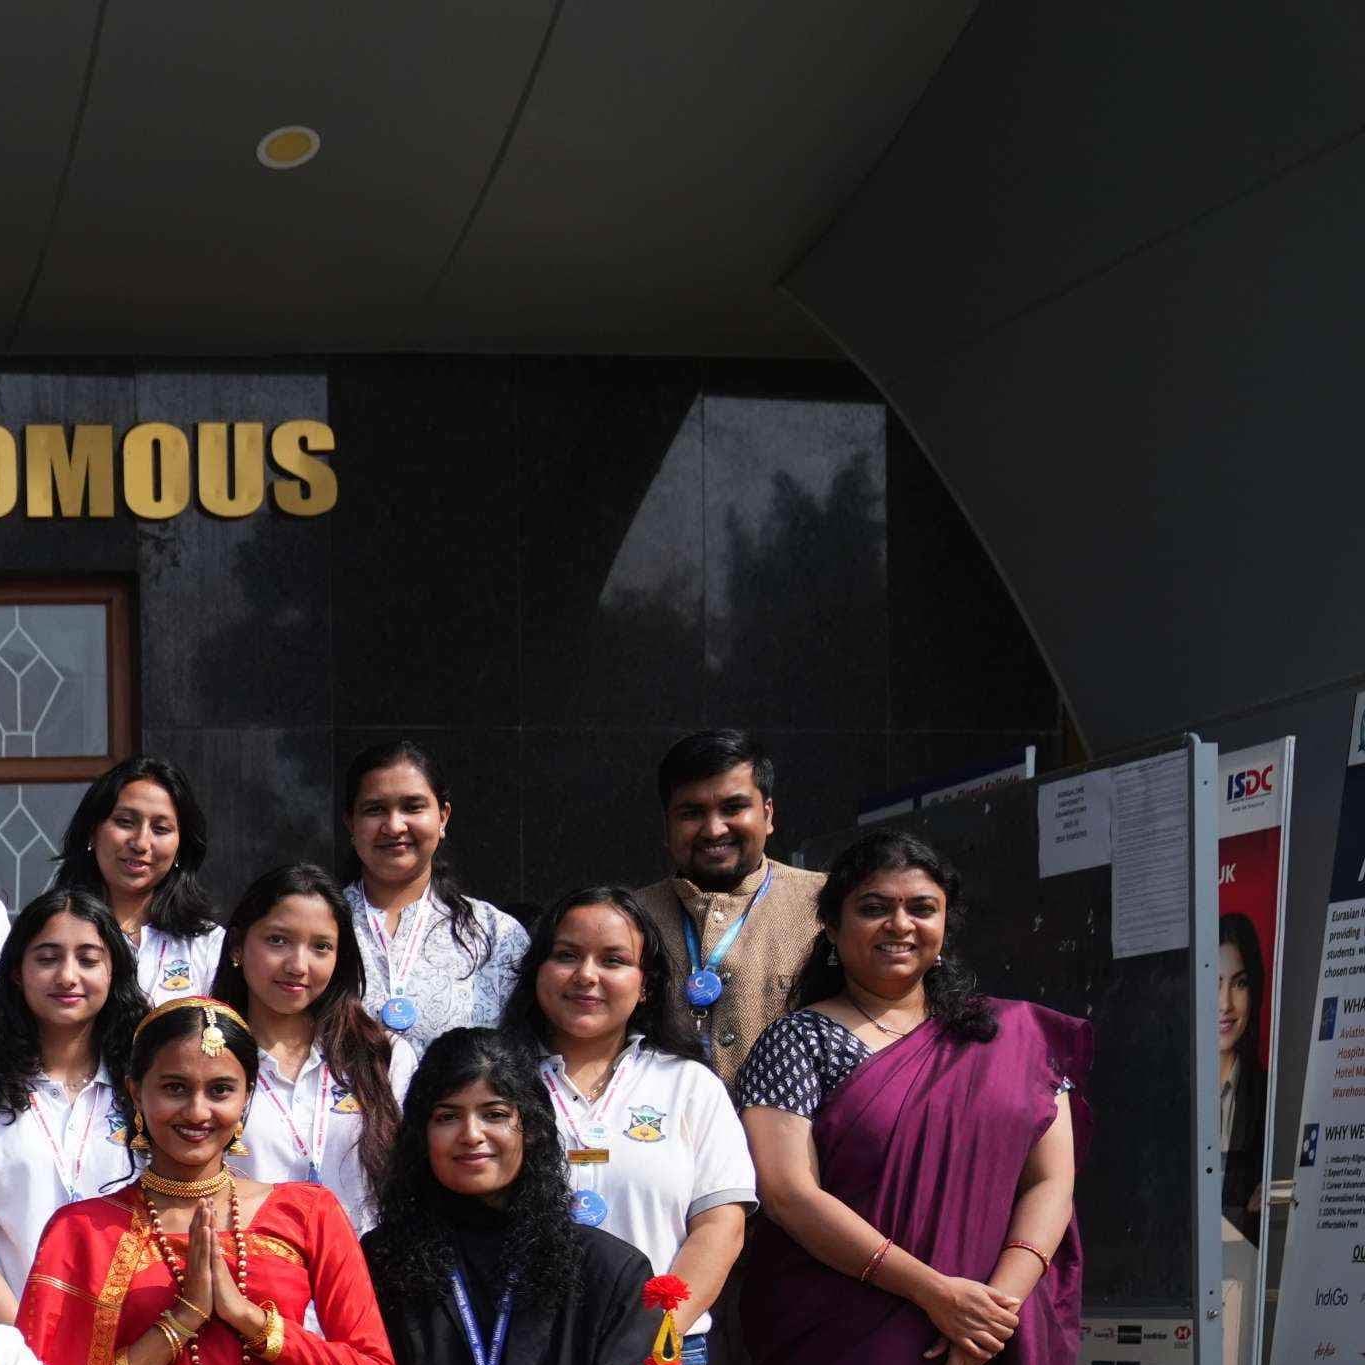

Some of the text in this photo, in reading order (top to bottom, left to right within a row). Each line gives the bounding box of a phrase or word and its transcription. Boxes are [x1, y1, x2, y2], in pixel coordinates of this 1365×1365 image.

[1227, 764, 1274, 801] ISDC
[1332, 909, 1360, 922] Eurasian
[1329, 927, 1360, 944] providing
[1327, 946, 1355, 960] students
[1324, 965, 1348, 978] chosen
[1344, 997, 1365, 1014] WHA
[1340, 1025, 1365, 1039] Aviatio
[1333, 1086, 1365, 1099] Warehous
[1325, 1124, 1348, 1141] WHY
[1315, 1288, 1349, 1307] IndiGo
